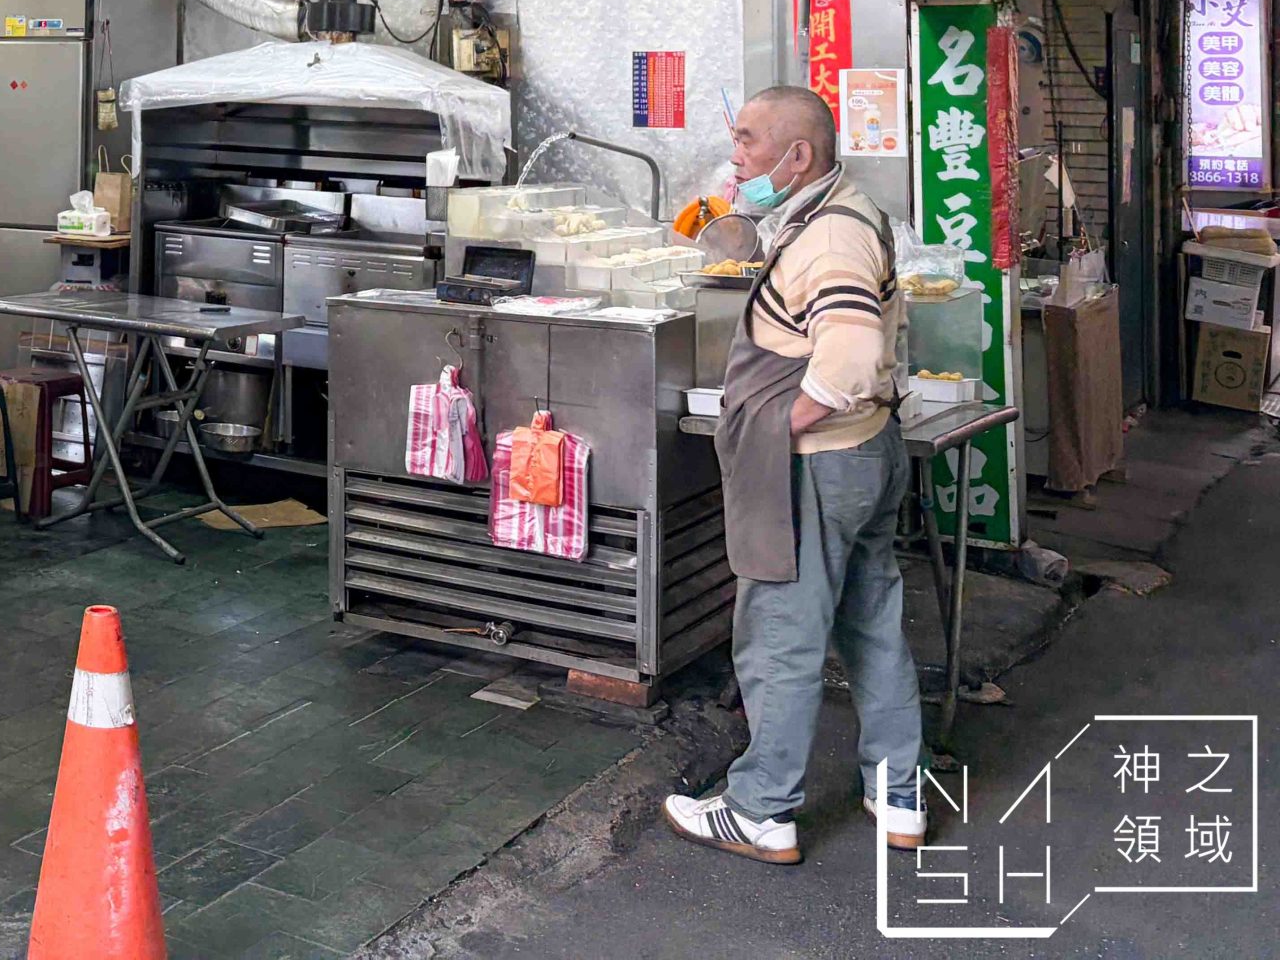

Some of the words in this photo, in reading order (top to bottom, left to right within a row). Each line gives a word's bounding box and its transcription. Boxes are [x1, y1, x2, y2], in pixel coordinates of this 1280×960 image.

[1202, 35, 1239, 51] 美甲
[1203, 61, 1240, 77] 美容
[927, 25, 1000, 518] 名豐豆品
